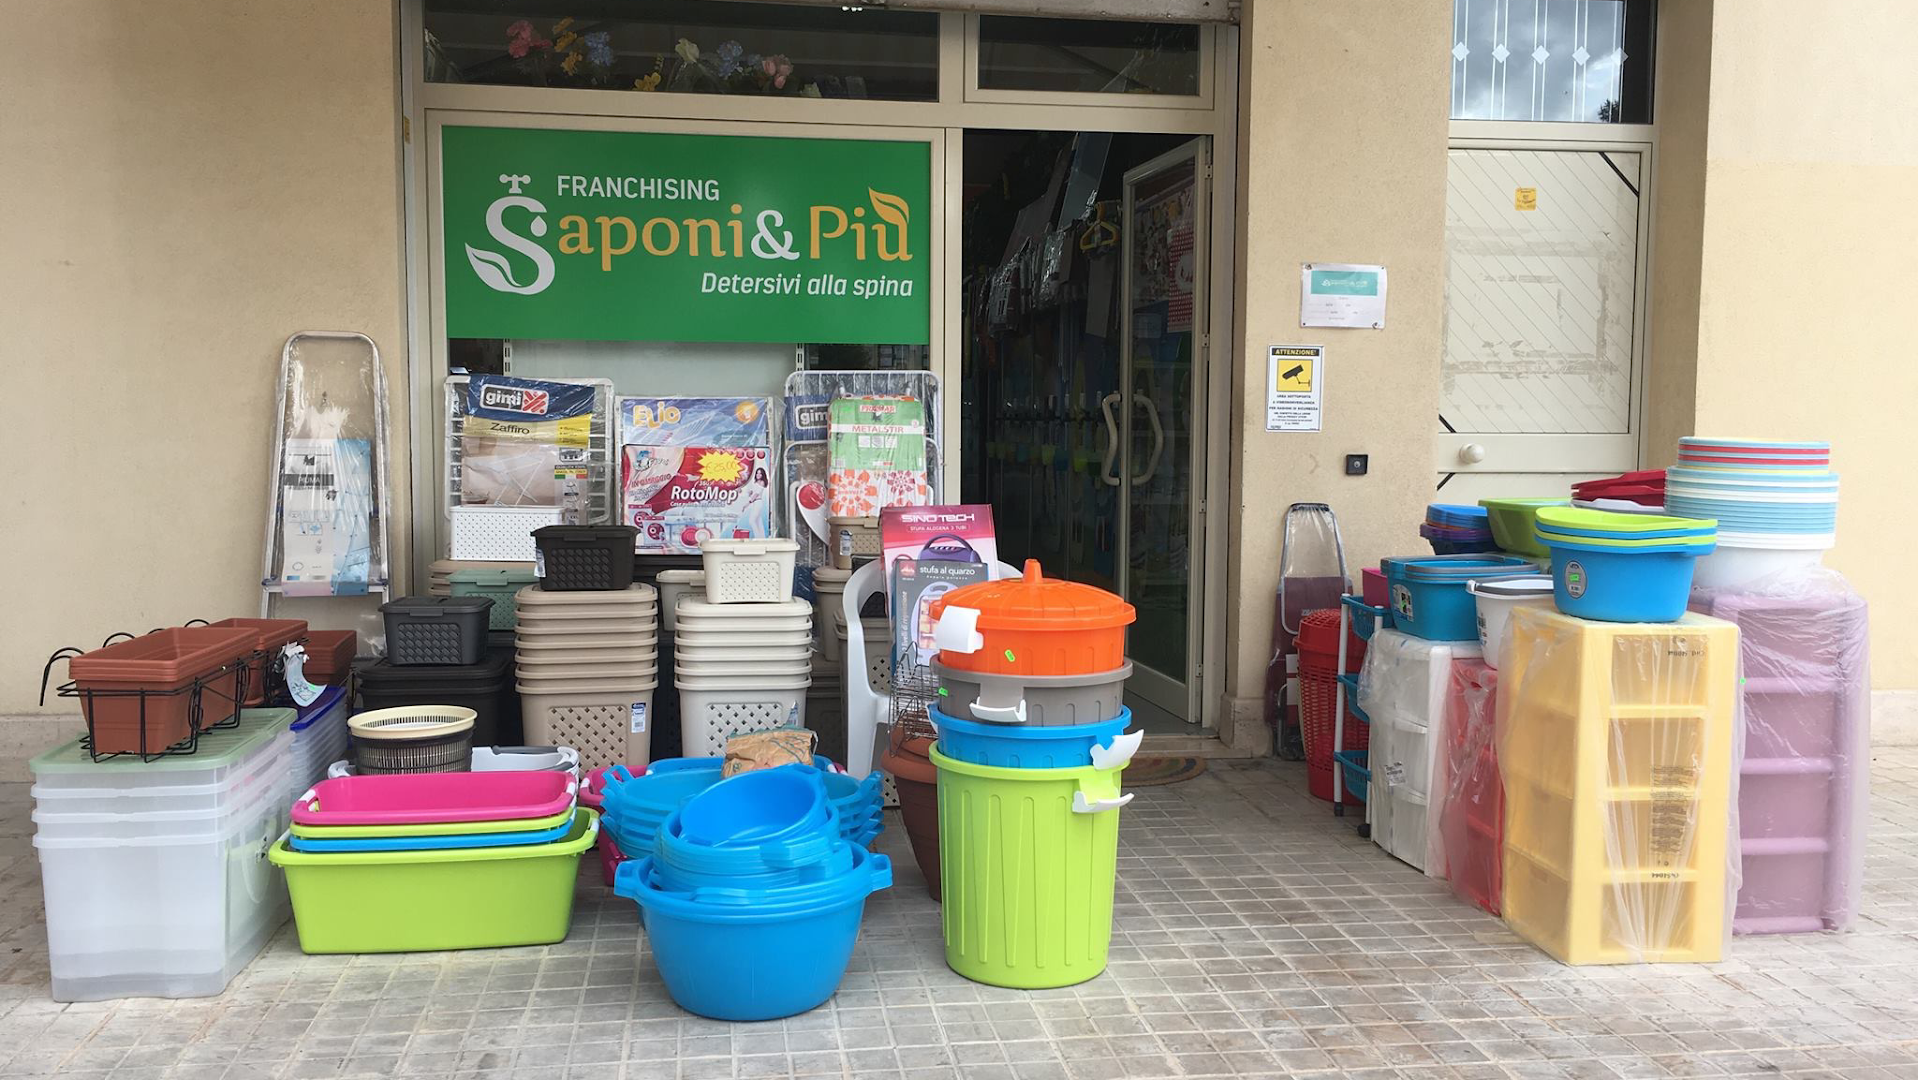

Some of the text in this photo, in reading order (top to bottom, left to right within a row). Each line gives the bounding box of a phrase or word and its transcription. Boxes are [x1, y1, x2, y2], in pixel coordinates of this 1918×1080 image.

[557, 175, 720, 201] FRANCHISING
[701, 272, 913, 299] Detersivi alla spina
[485, 389, 522, 407] gimi
[800, 409, 828, 425] gim
[490, 422, 530, 435] Zaffiro
[852, 425, 904, 433] METALSTIR
[670, 485, 738, 503] RotoMop
[919, 565, 976, 577] stufa al quarzo
